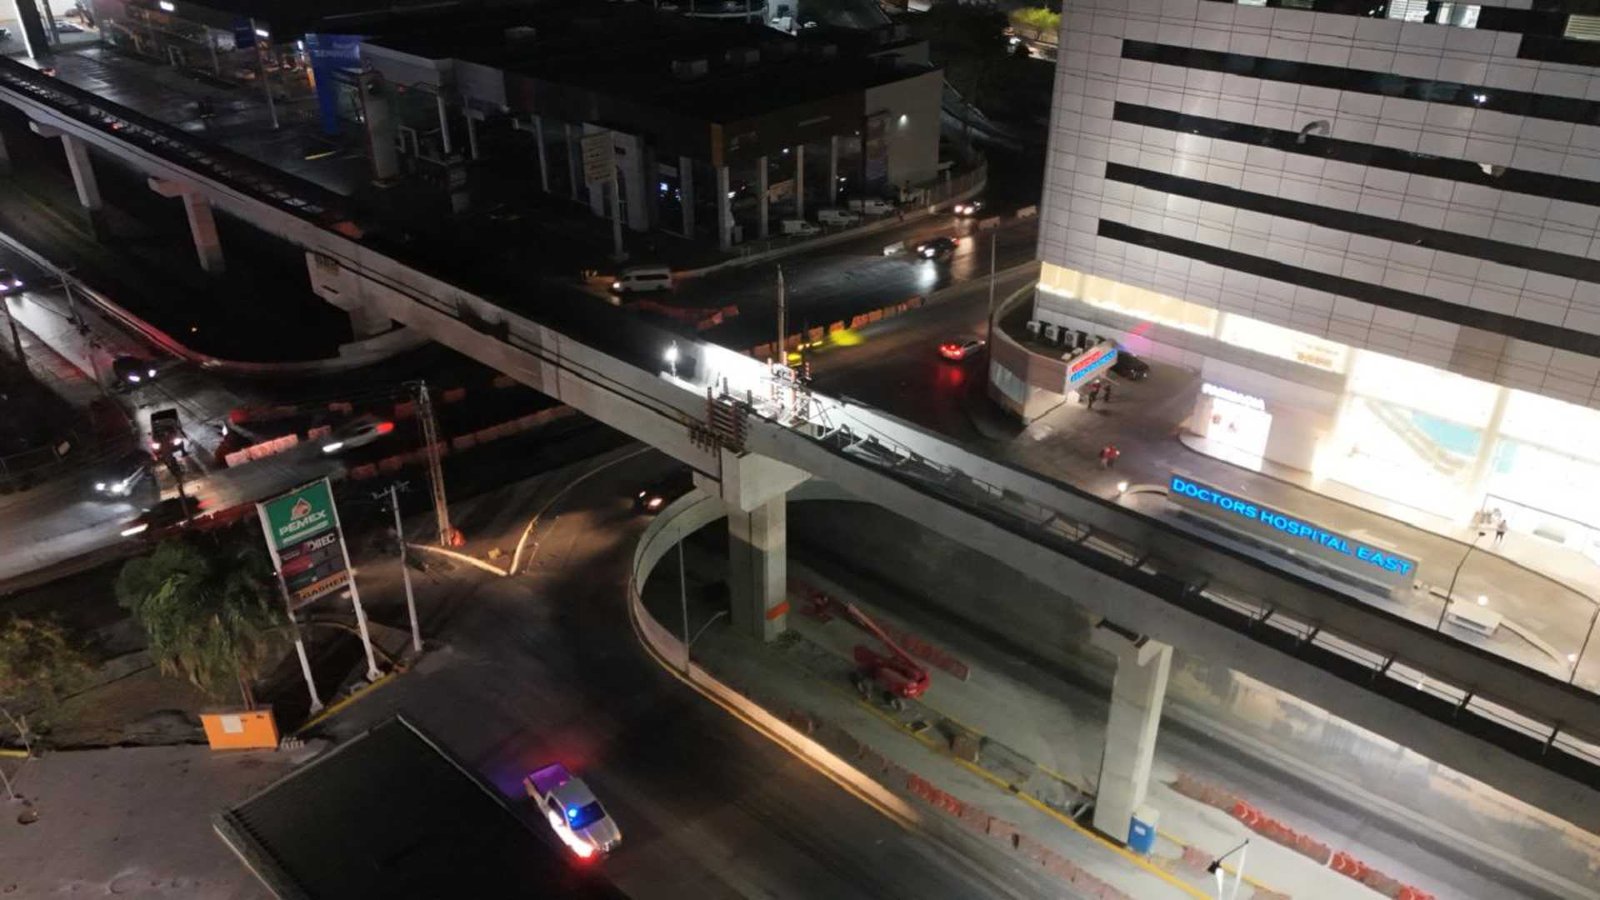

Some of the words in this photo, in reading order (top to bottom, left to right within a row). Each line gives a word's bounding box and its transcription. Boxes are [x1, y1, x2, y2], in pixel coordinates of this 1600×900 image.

[279, 510, 326, 535] PEMEX
[1172, 478, 1257, 519] DOCTORS
[1260, 511, 1352, 554] HOSPITAL
[1356, 546, 1413, 576] EAST
